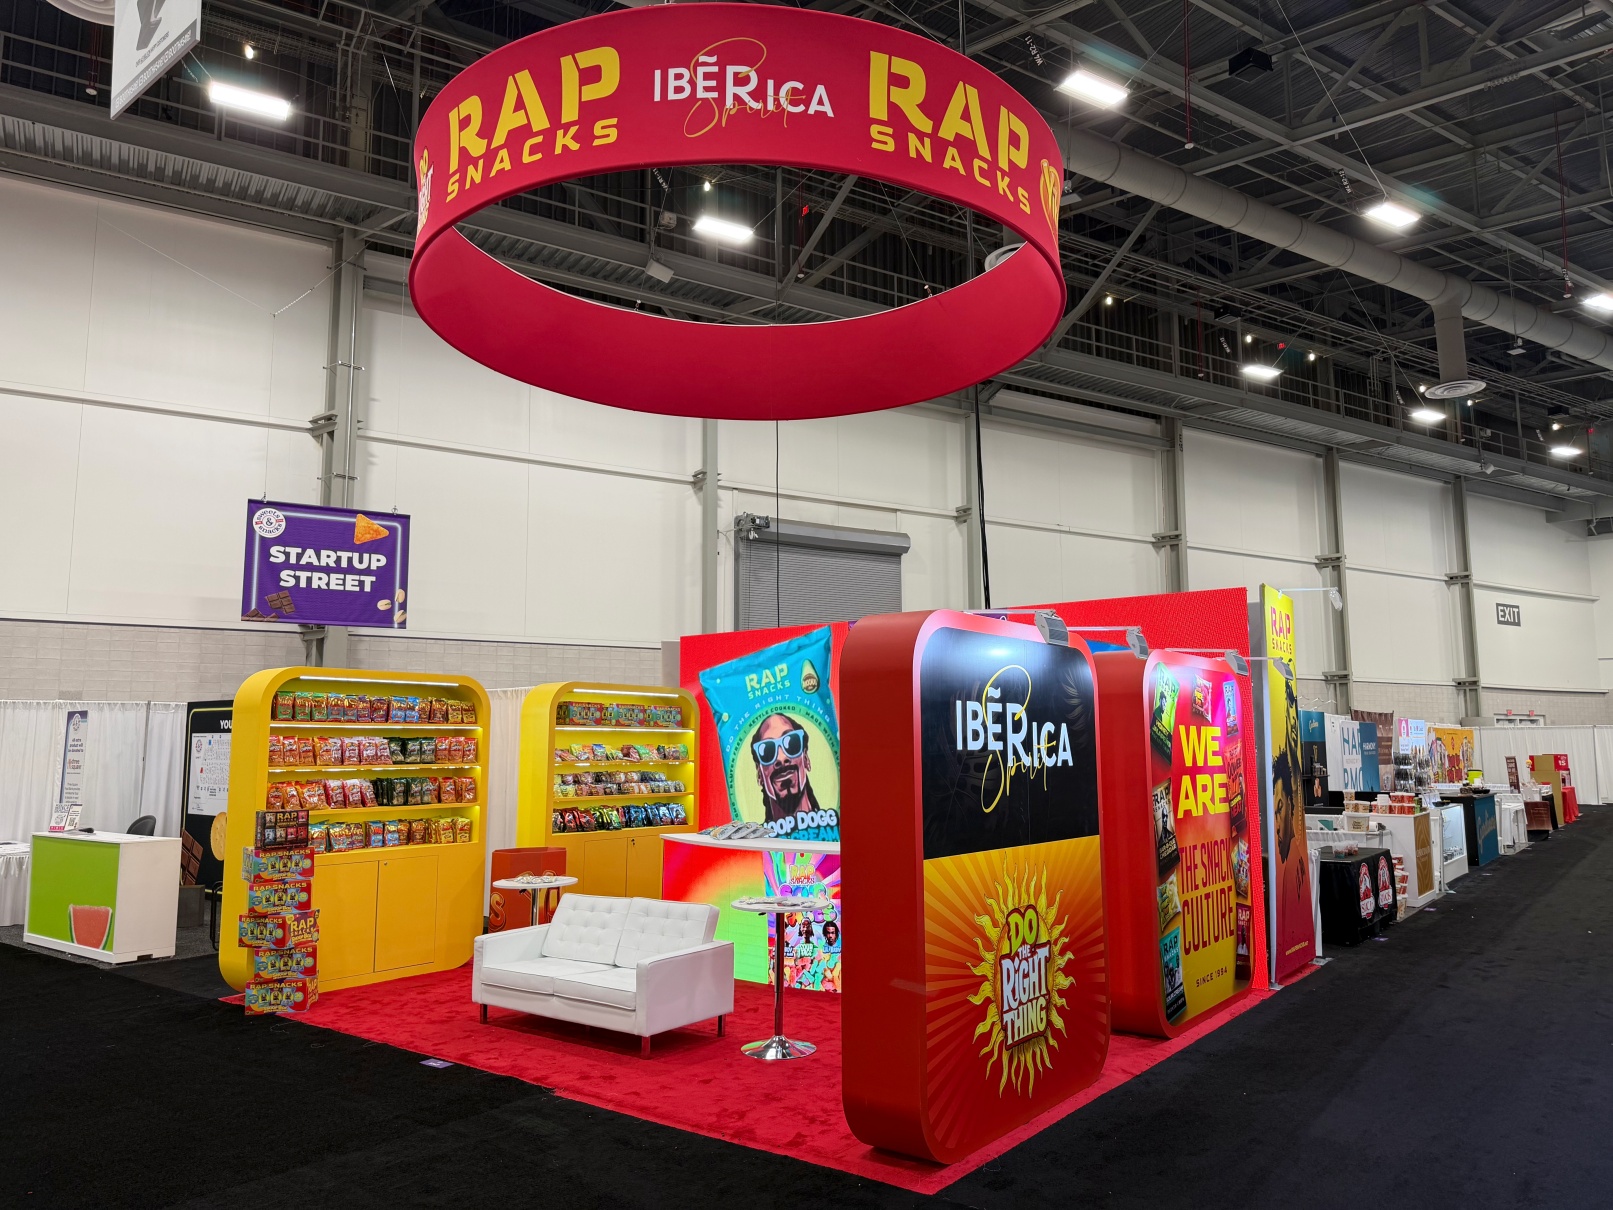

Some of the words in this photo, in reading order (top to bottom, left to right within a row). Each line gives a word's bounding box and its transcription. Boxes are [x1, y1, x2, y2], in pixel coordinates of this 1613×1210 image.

[684, 37, 806, 138] Spirit
[449, 47, 620, 174] RAP
[869, 51, 1029, 172] RAP
[446, 118, 618, 203] SNACKS
[870, 124, 1031, 215] SNACKS
[266, 517, 274, 527] &
[269, 545, 387, 570] STARTUP
[279, 570, 376, 592] STREET
[1271, 606, 1290, 640] RAP
[1498, 606, 1518, 622] EXIT
[1272, 637, 1292, 655] SNACKS
[745, 663, 789, 692] RAP
[748, 680, 791, 700] SNACKS
[1159, 669, 1176, 692] RAP
[726, 735, 734, 752] DO
[735, 712, 750, 730] THE
[755, 695, 789, 709] RIGHT
[797, 696, 830, 722] THING
[749, 710, 769, 727] KETTLE
[981, 664, 1056, 813] Spirit
[1179, 725, 1223, 767] WE
[1154, 787, 1170, 804] RAP
[1177, 773, 1230, 819] ARE
[277, 812, 297, 820] RAP
[763, 816, 795, 838] OOP
[797, 811, 837, 830] DOGG
[277, 849, 311, 857] SNACKS
[1179, 845, 1199, 895] THE
[1200, 836, 1233, 889] SNACK
[790, 865, 815, 878] RAP
[291, 918, 314, 931] RAP
[1182, 885, 1234, 956] CULTURE
[1238, 909, 1250, 921] RAP
[1008, 908, 1038, 956] DO
[1018, 945, 1030, 960] THE
[1164, 936, 1178, 954] RAP
[1196, 972, 1214, 987] SINCE
[1003, 997, 1046, 1045] THING
